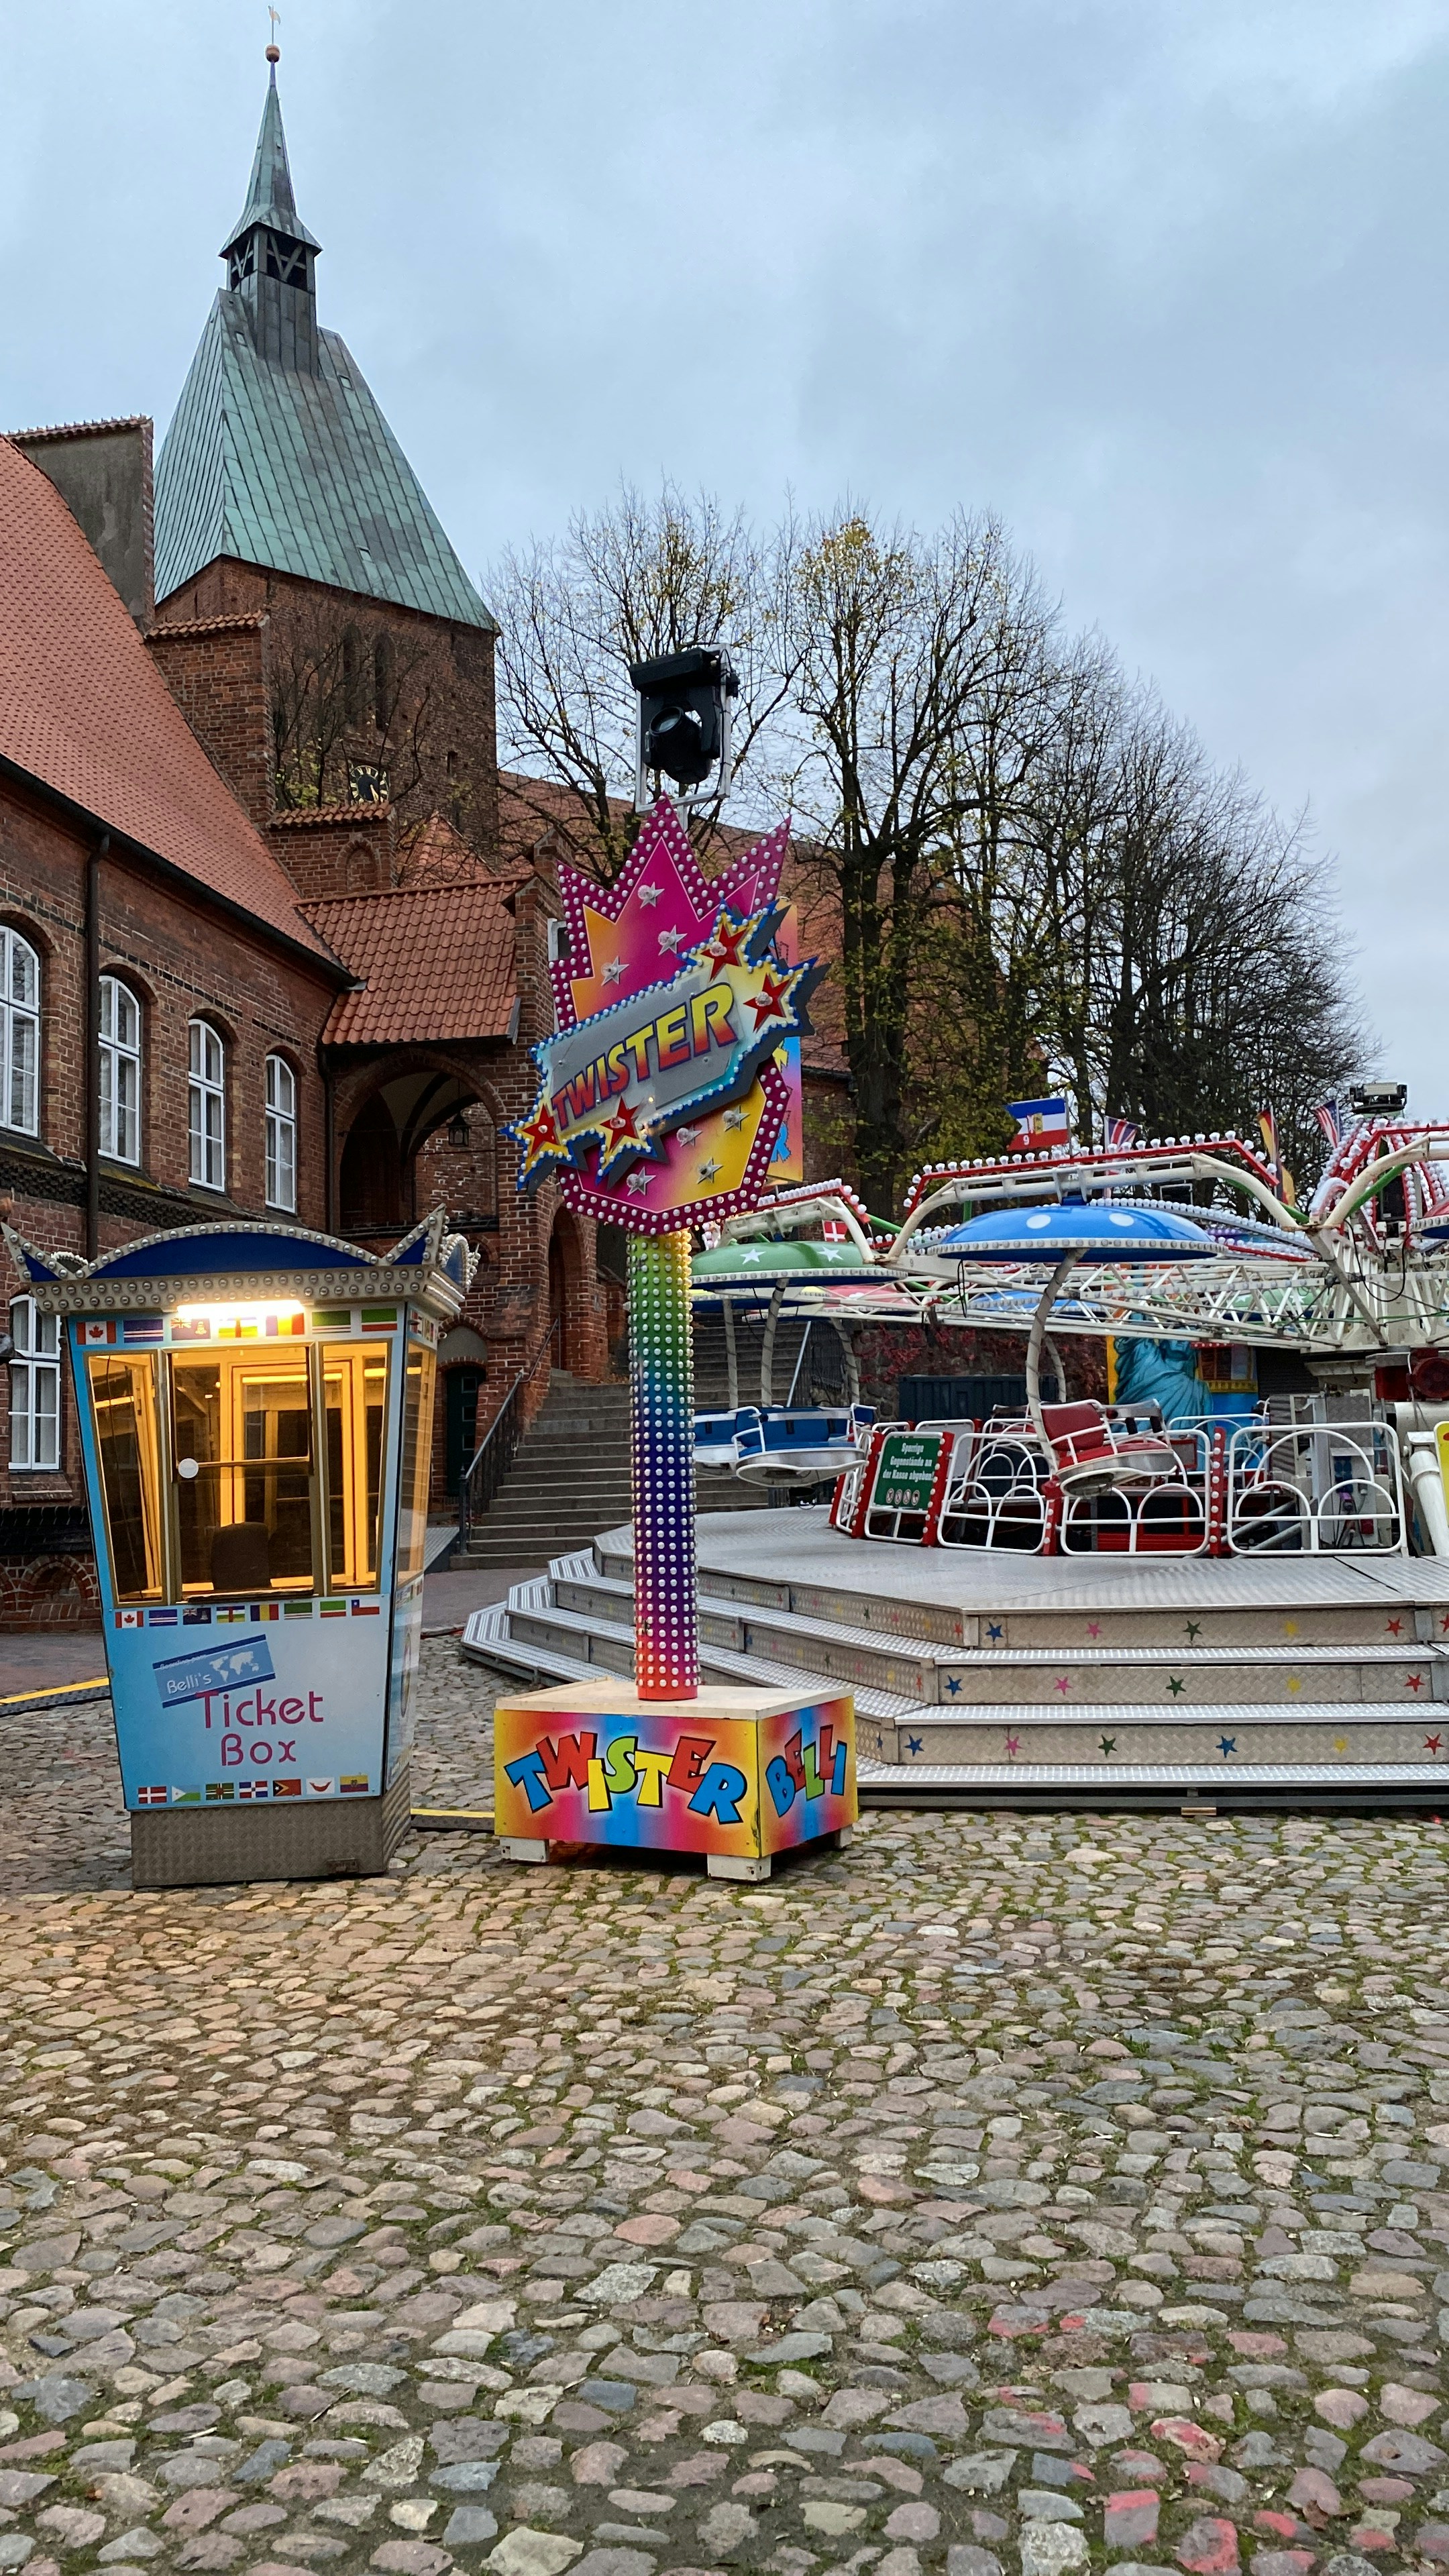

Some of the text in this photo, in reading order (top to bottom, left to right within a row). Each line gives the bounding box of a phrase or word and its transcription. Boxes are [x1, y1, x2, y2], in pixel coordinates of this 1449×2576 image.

[551, 982, 739, 1131] TWISTER
[883, 1469, 892, 1479] der
[892, 1469, 908, 1479] Kasse
[167, 1672, 212, 1695] Belli's
[195, 1688, 324, 1729] Ticket
[221, 1733, 297, 1766] Box
[504, 1731, 748, 1825] TWISTER
[765, 1724, 847, 1818] BELLI
